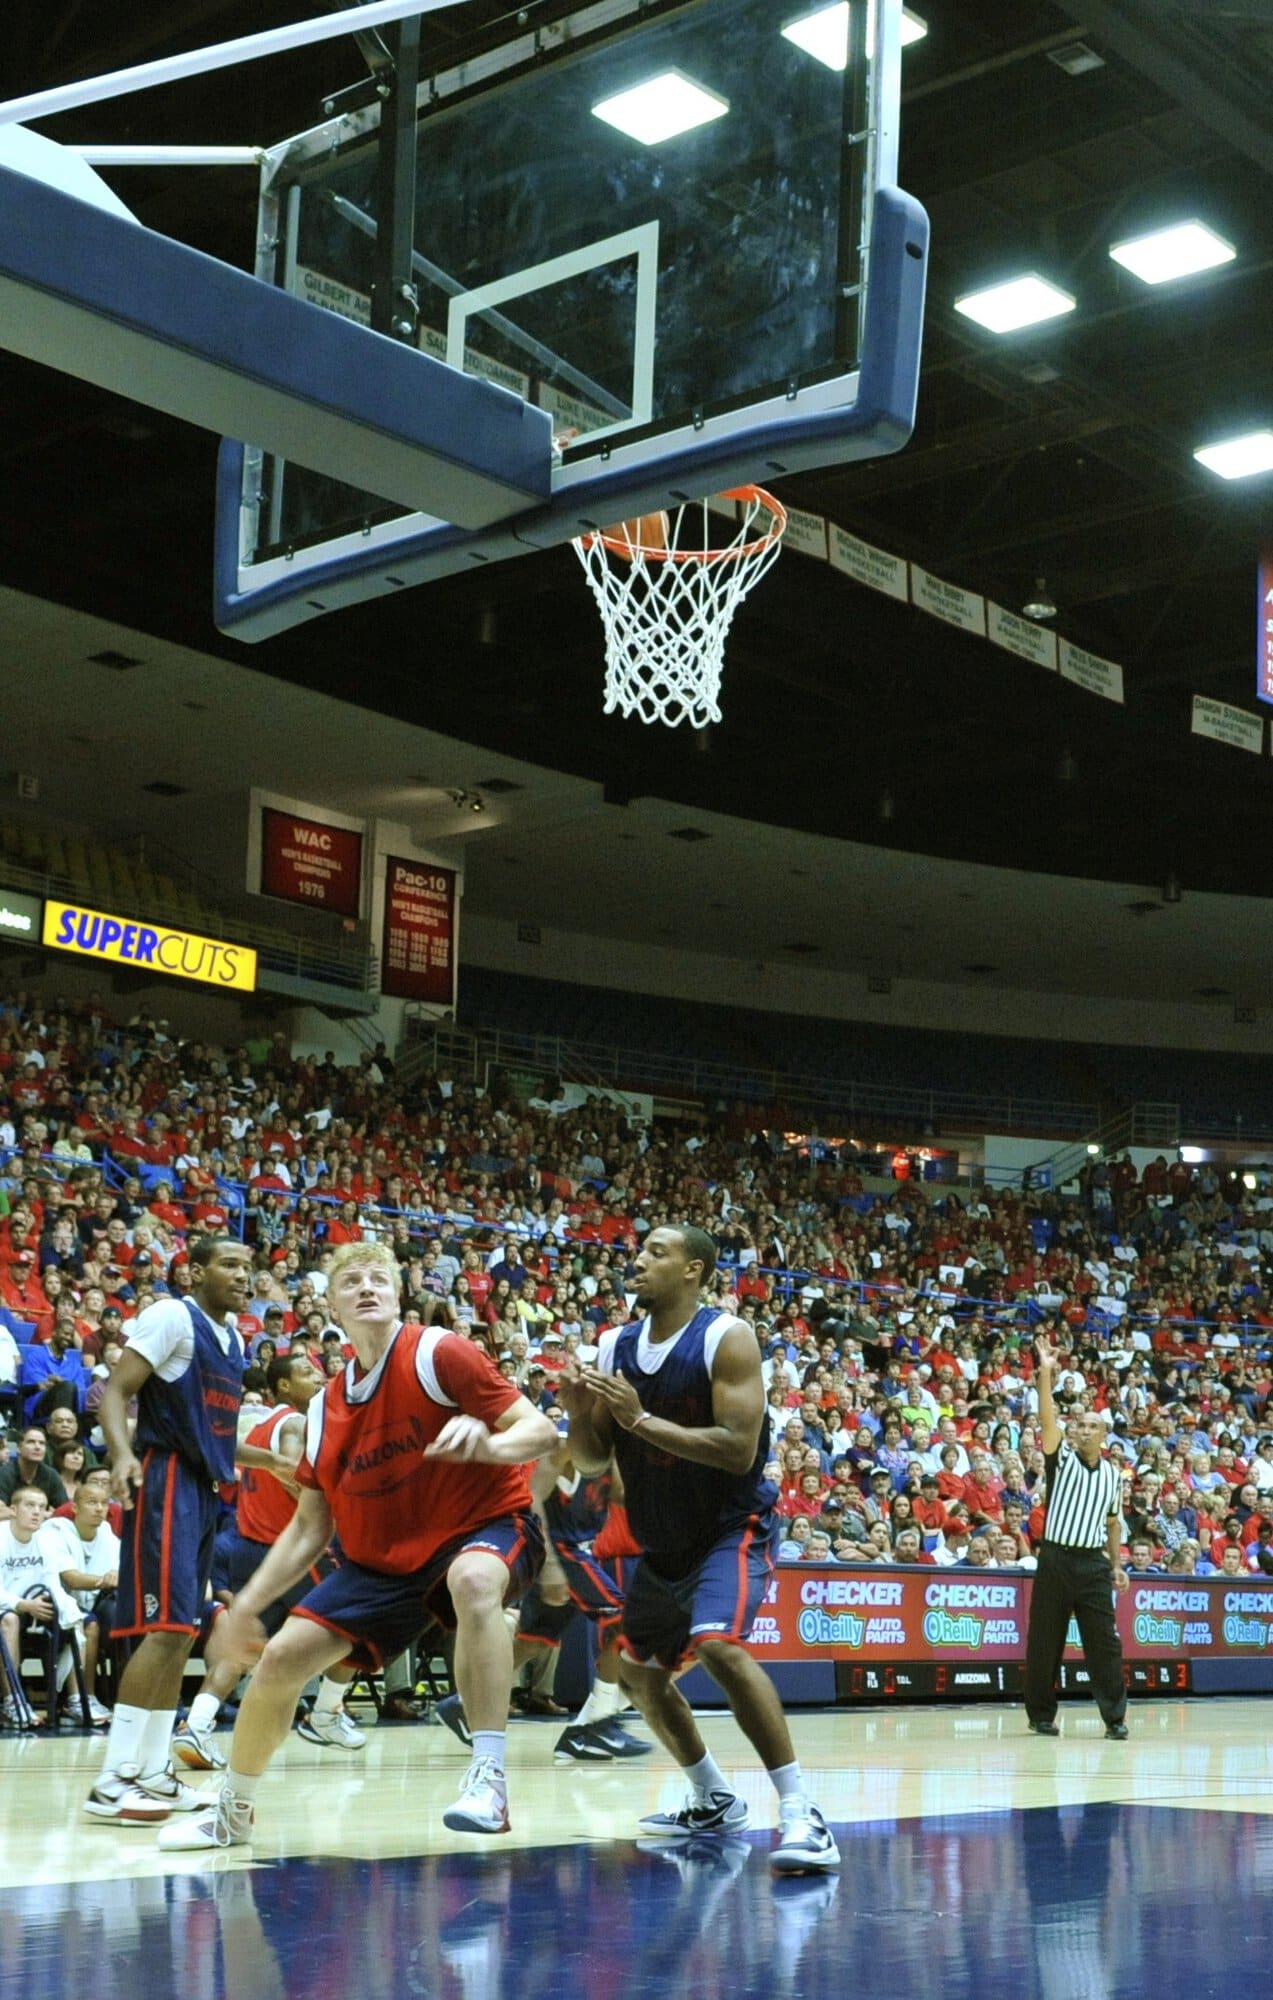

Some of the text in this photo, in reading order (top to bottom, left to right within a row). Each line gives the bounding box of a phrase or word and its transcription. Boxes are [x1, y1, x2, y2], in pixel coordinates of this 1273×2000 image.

[304, 272, 351, 306] GILBERT
[353, 295, 370, 314] AR
[293, 827, 332, 851] WAC
[395, 867, 447, 892] Pac-10
[393, 883, 448, 903] CONFERENCE
[56, 909, 240, 982] SUPERCUTS
[801, 1581, 904, 1605] CHECKER
[925, 1584, 1016, 1608] CHECKER
[1135, 1589, 1210, 1611] CHECKER
[1224, 1592, 1273, 1612] CHECK
[800, 1609, 863, 1646] O'Reilly
[866, 1618, 902, 1630] AUTO
[924, 1611, 981, 1646] O'Reilly
[984, 1620, 1015, 1632] AUTO
[1135, 1614, 1181, 1646] O'Reilly
[1184, 1622, 1209, 1633] AUTO
[1224, 1615, 1267, 1646] O'Reilly
[745, 1631, 781, 1643] ARTS
[865, 1631, 906, 1643] PARTS
[983, 1632, 1019, 1644] PARTS
[1183, 1633, 1212, 1644] PARTS
[954, 1673, 991, 1684] ARIZONA
